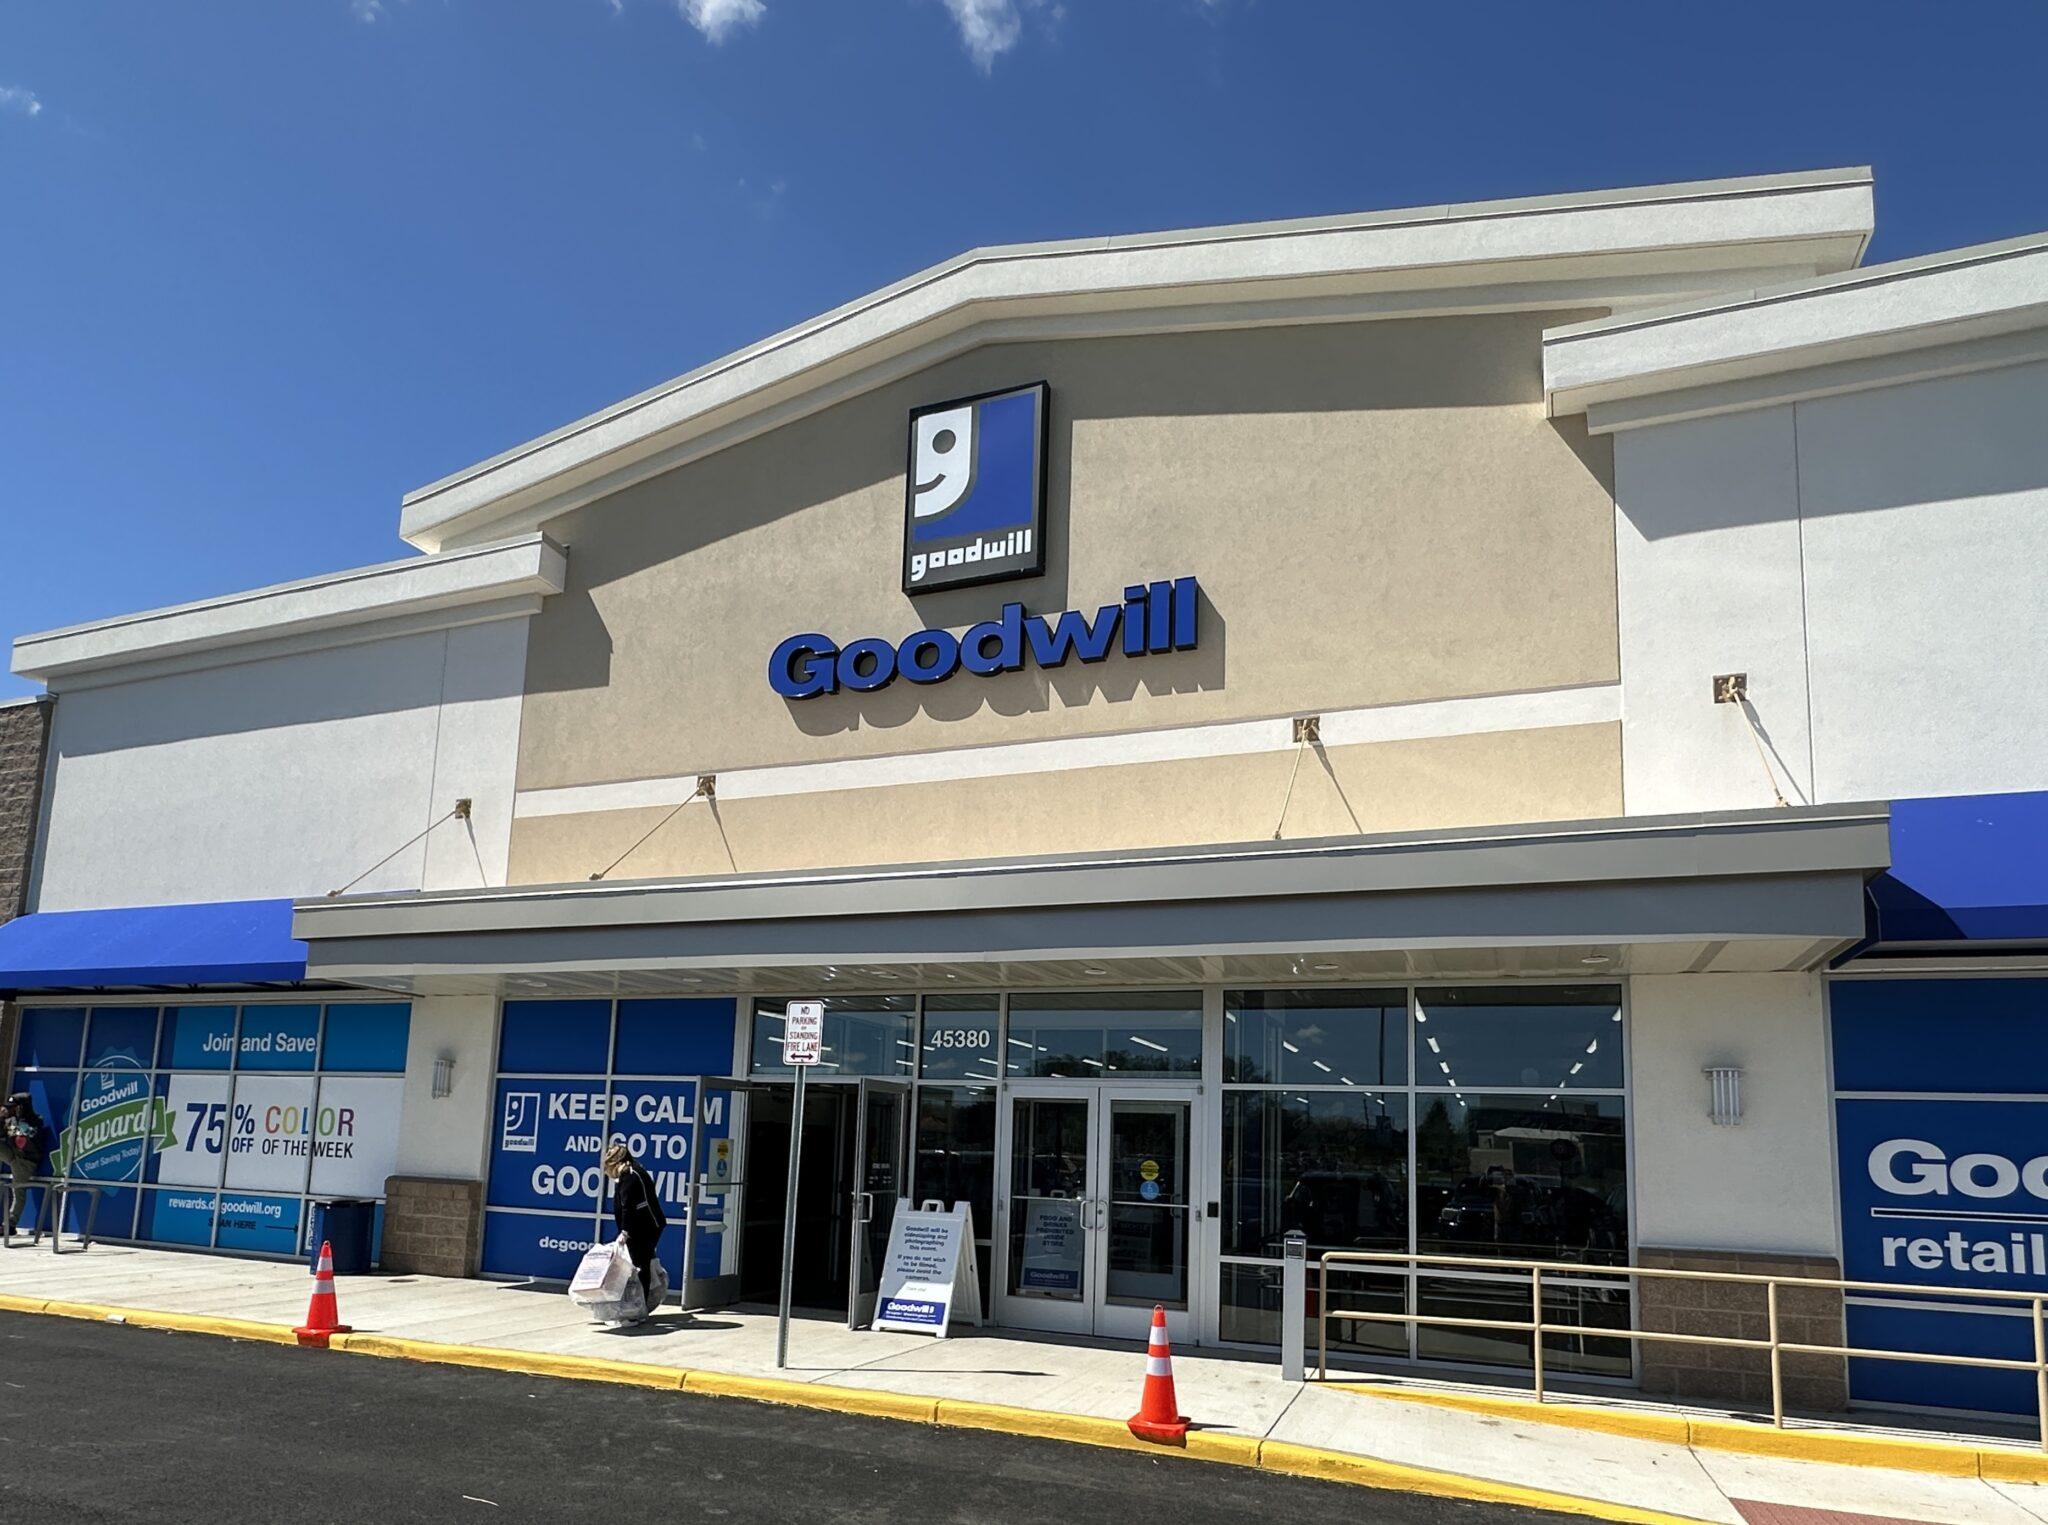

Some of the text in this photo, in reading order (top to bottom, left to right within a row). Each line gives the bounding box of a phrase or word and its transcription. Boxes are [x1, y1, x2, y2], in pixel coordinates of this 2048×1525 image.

[910, 529, 1032, 582] goodwill
[768, 576, 1199, 699] Goodwill
[801, 1006, 810, 1015] NO
[792, 1017, 817, 1025] PARKING
[240, 1033, 272, 1052] and
[789, 1031, 817, 1039] STANDING
[931, 1029, 990, 1048] 45380
[786, 1042, 818, 1051] FIRE LANE
[81, 1080, 138, 1112] Goodwill
[548, 1093, 723, 1125] KEEP CALM
[265, 1105, 355, 1137] COLOR
[231, 1137, 354, 1159] OFF OF THE WEEK
[565, 1136, 602, 1152] AND
[650, 1135, 687, 1160] TO
[169, 1198, 282, 1218] rewards.dgoodwill.org
[208, 1219, 257, 1230] SAN HERE
[1882, 1230, 2047, 1276] retail
[887, 1302, 930, 1314] Goodwill
